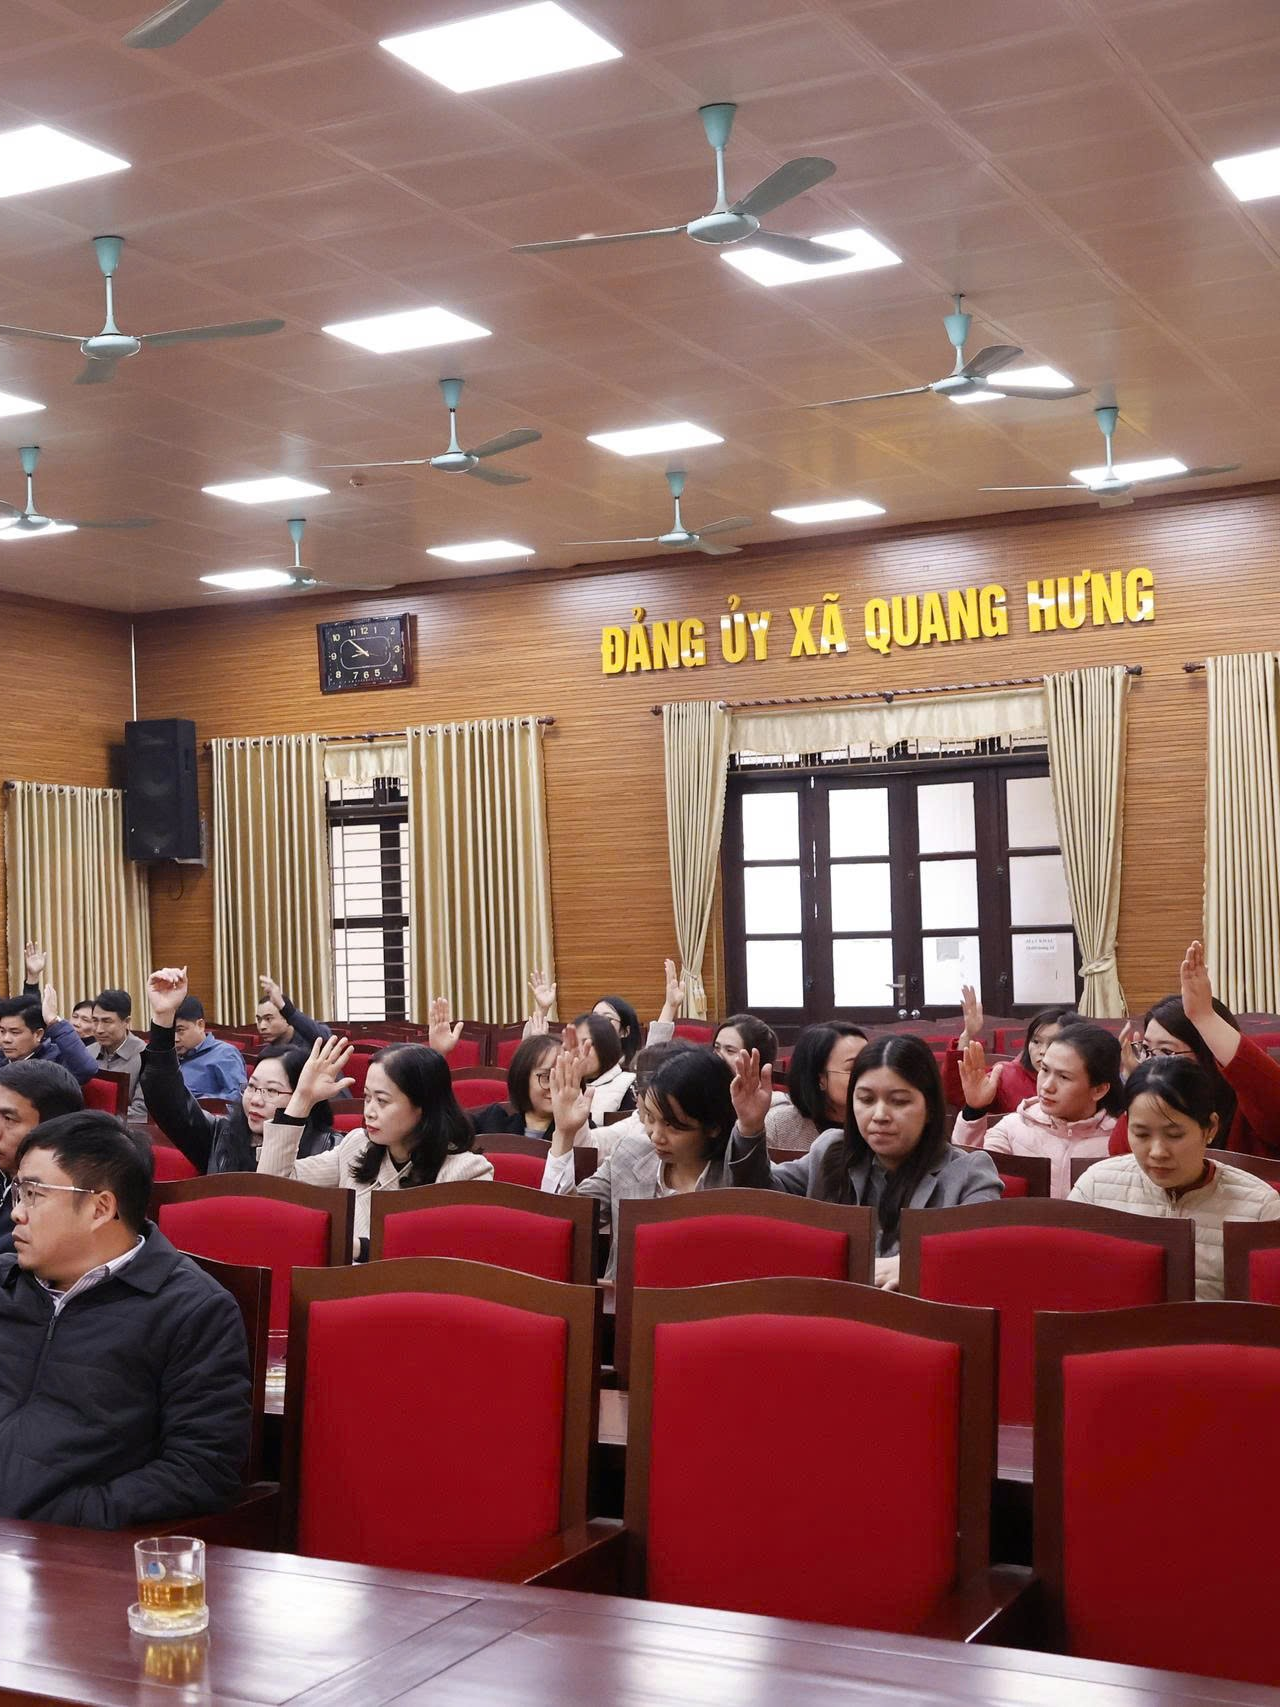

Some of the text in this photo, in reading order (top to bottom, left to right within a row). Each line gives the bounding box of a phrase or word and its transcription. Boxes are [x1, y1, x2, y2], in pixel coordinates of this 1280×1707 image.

[601, 567, 1156, 675] ĐẢNG ỦY XÃ QUANG HƯNG
[349, 628, 357, 637] 11
[360, 627, 369, 635] 12
[390, 626, 396, 635] 2
[332, 633, 341, 642] 10
[394, 645, 400, 653] 3
[330, 652, 337, 660] 9
[392, 664, 398, 672] 4
[335, 670, 342, 678] 8
[353, 671, 359, 680] 7
[363, 671, 369, 679] 6
[374, 668, 381, 677] 5
